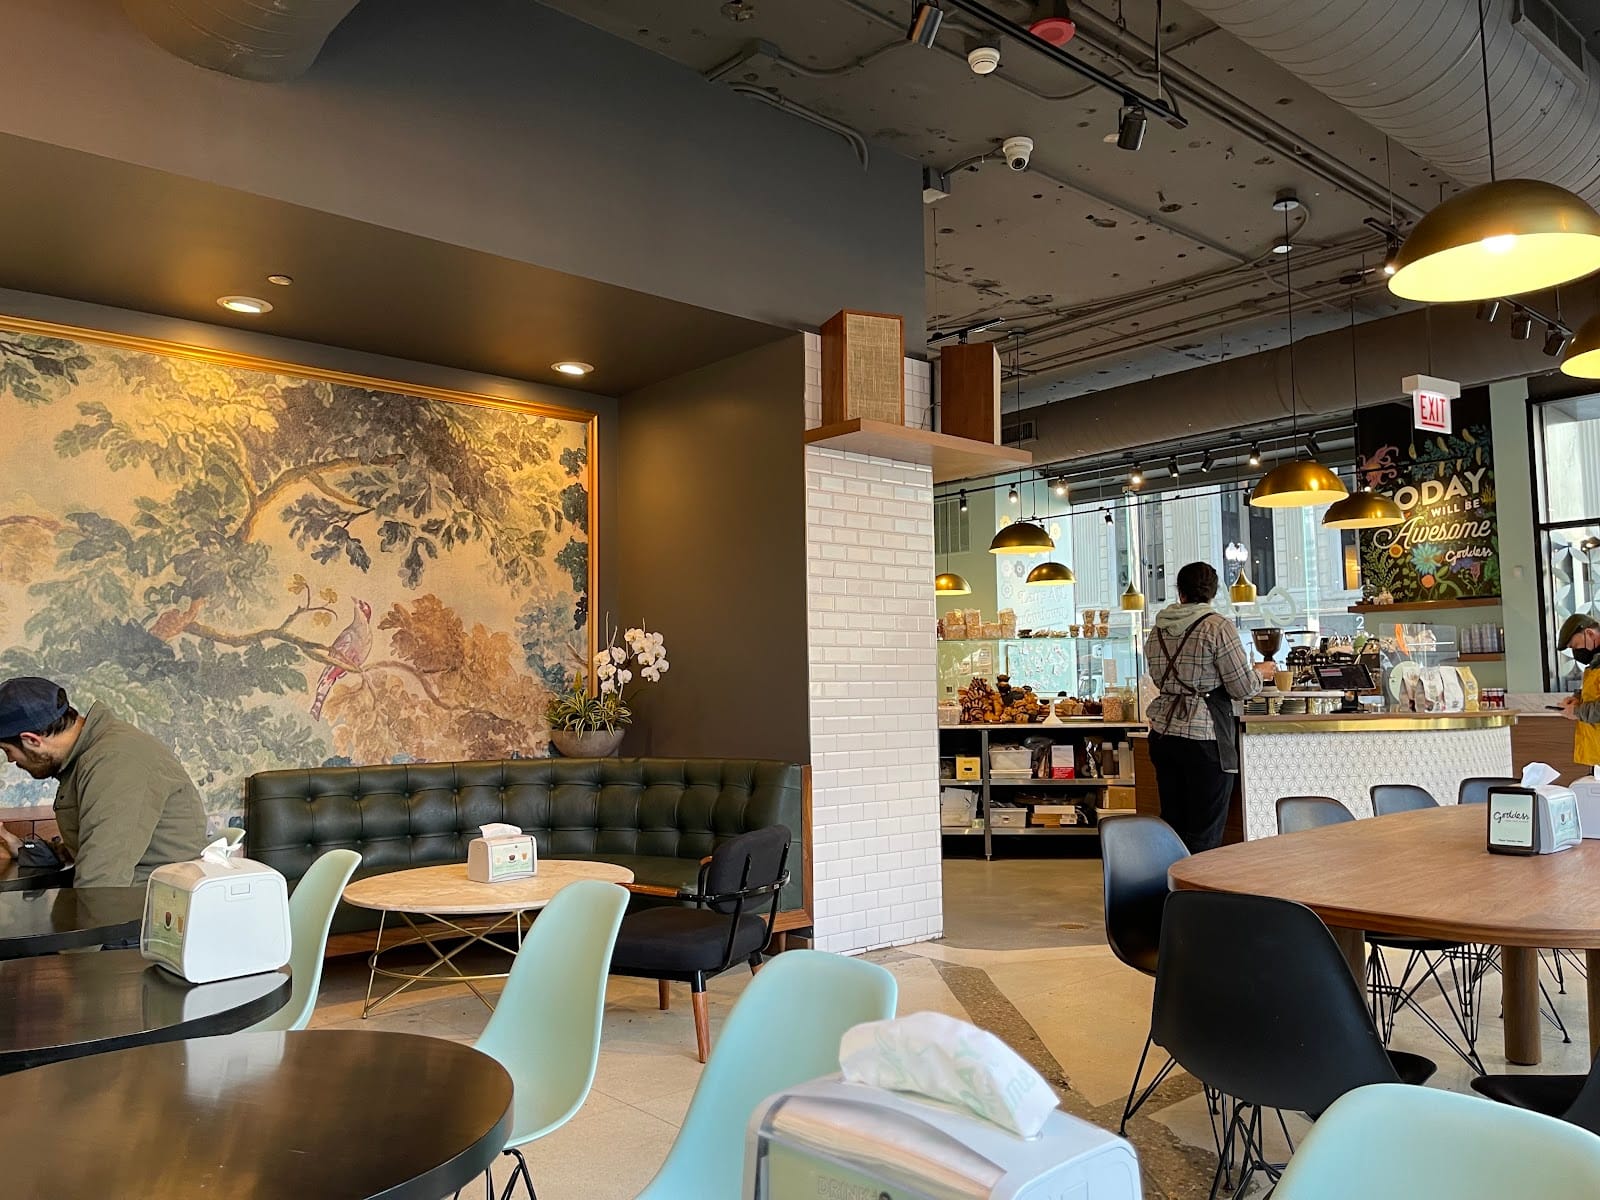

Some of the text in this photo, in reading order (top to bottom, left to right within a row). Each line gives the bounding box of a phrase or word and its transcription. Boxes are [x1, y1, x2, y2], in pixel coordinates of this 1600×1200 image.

[1420, 394, 1446, 423] EXIT
[1430, 498, 1481, 518] WILL BE
[1373, 516, 1491, 549] Awesome
[1445, 545, 1493, 566] Goddess
[1355, 615, 1365, 630] 2
